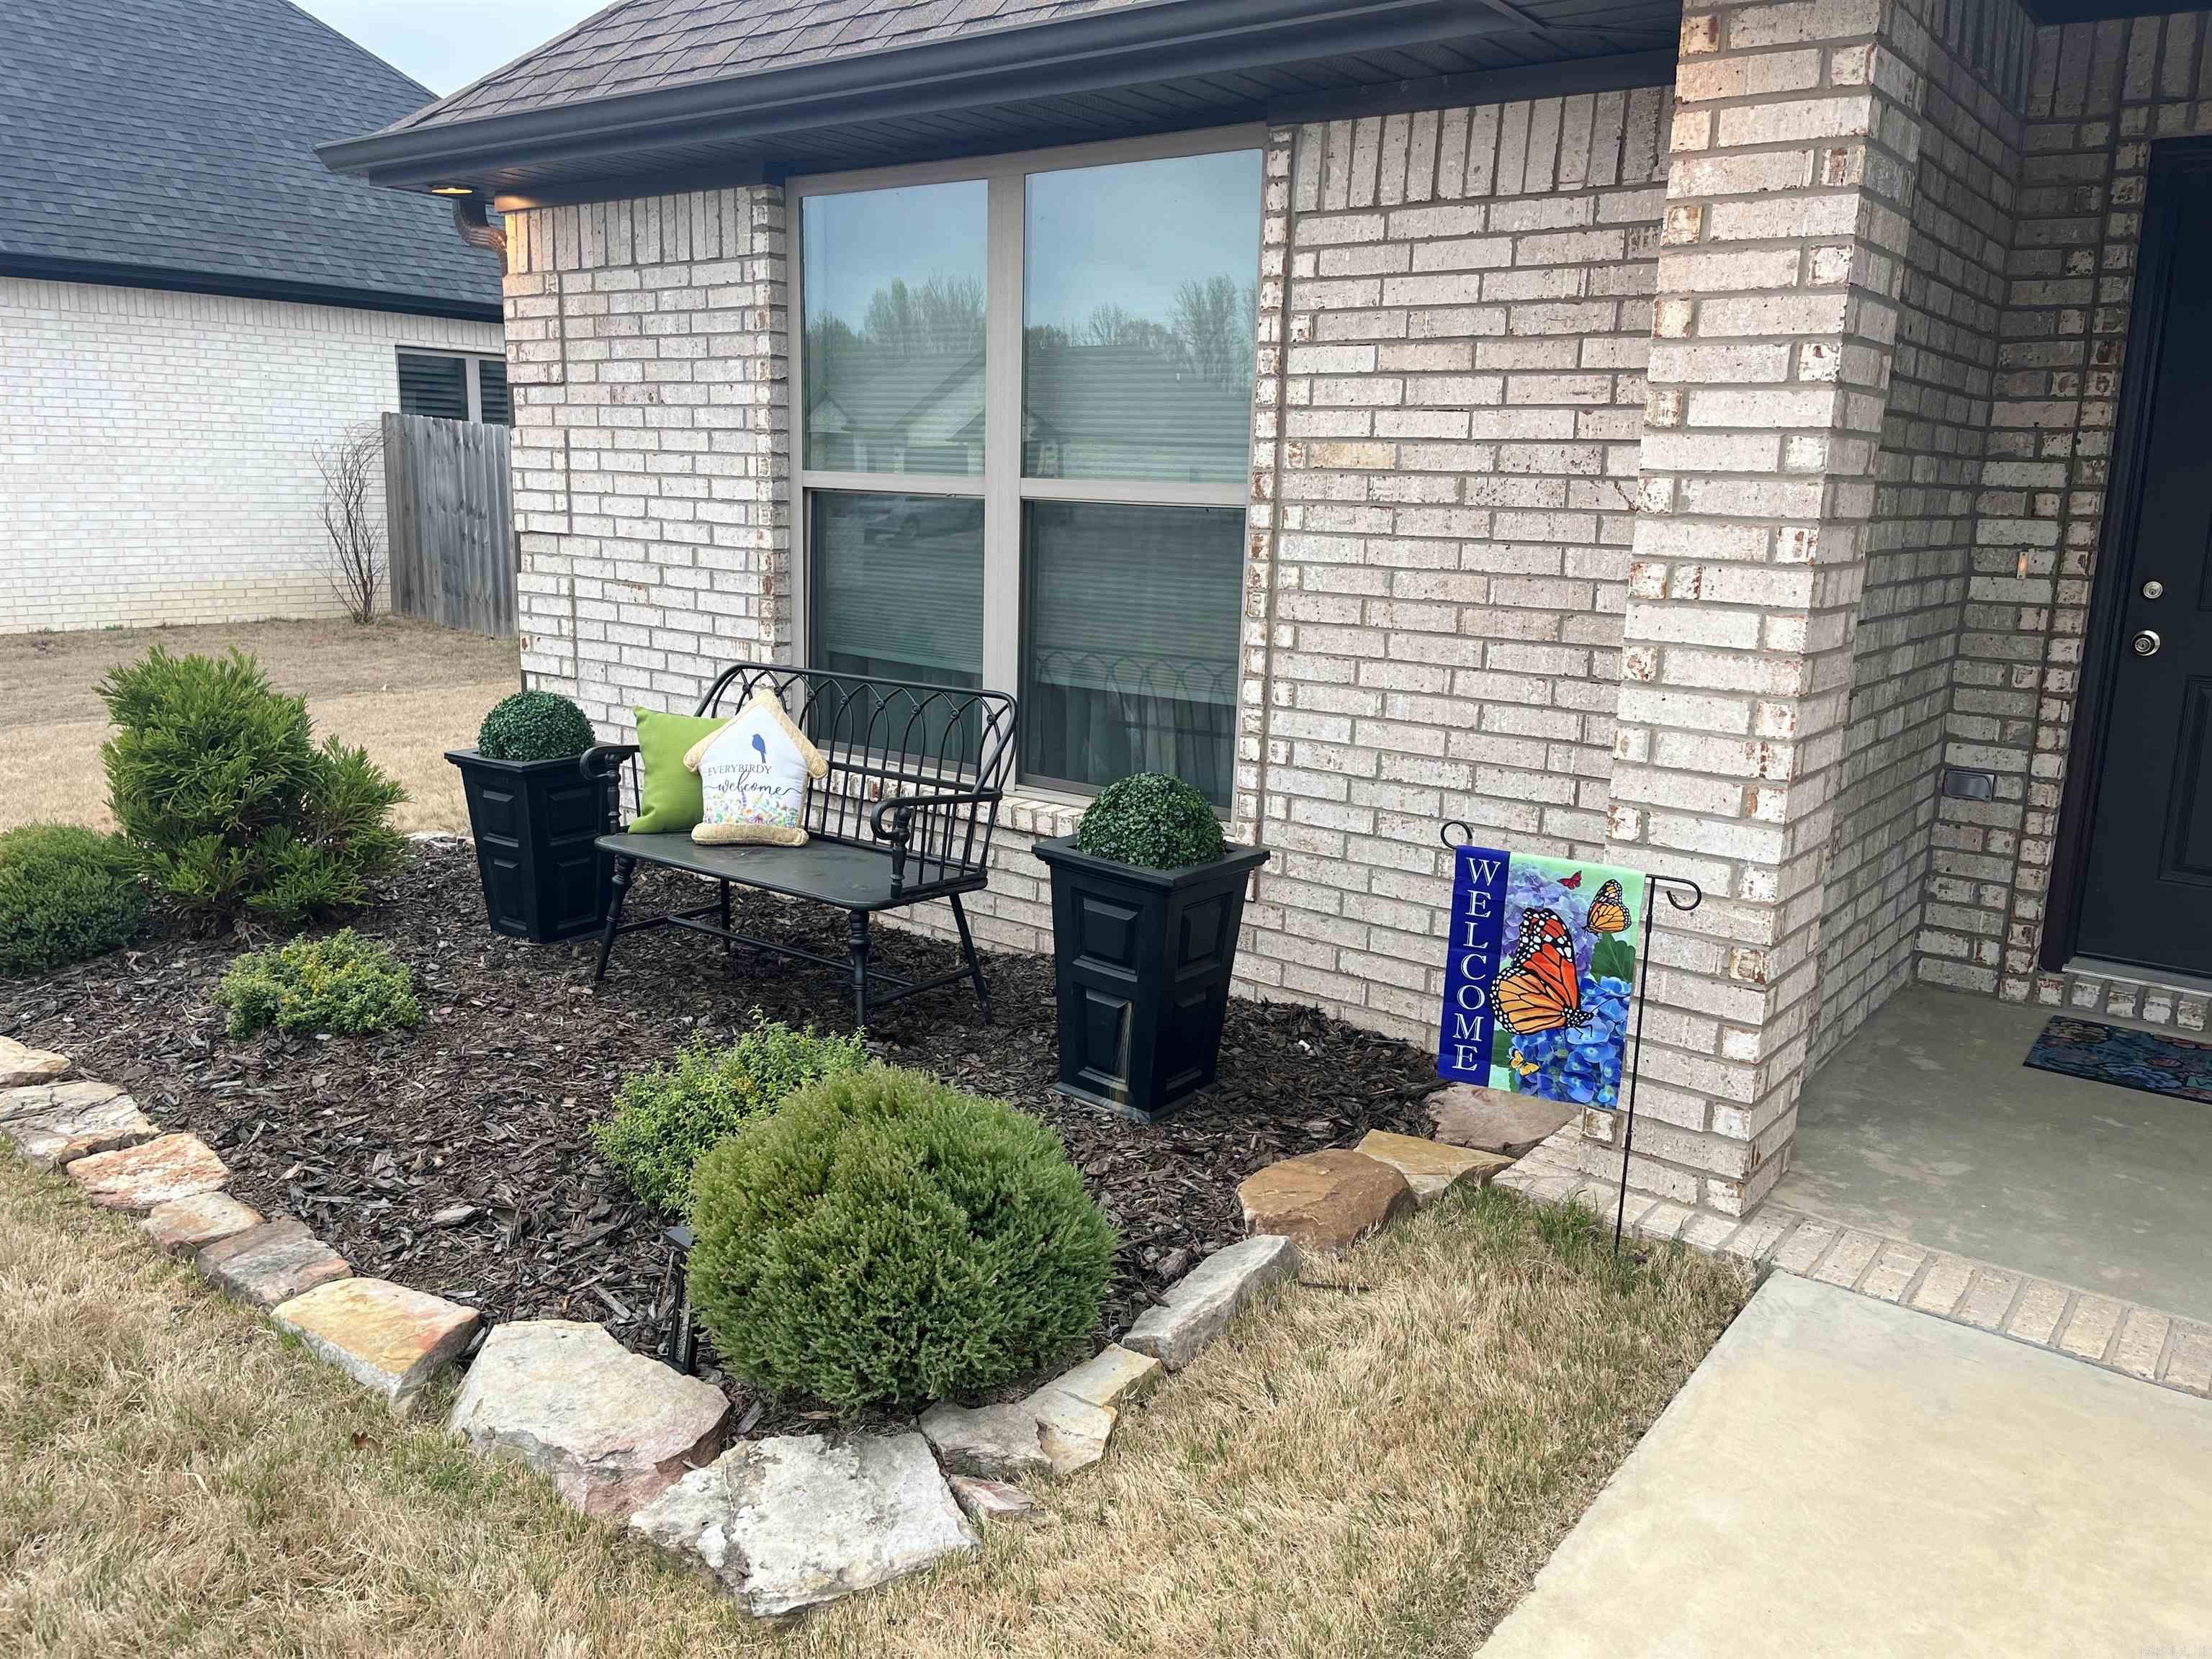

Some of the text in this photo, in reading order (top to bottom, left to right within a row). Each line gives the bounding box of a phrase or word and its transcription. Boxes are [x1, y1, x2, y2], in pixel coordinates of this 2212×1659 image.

[703, 768, 802, 796] welcome
[708, 764, 772, 775] EVERYBIRDY
[1452, 858, 1501, 1071] WELCOME
